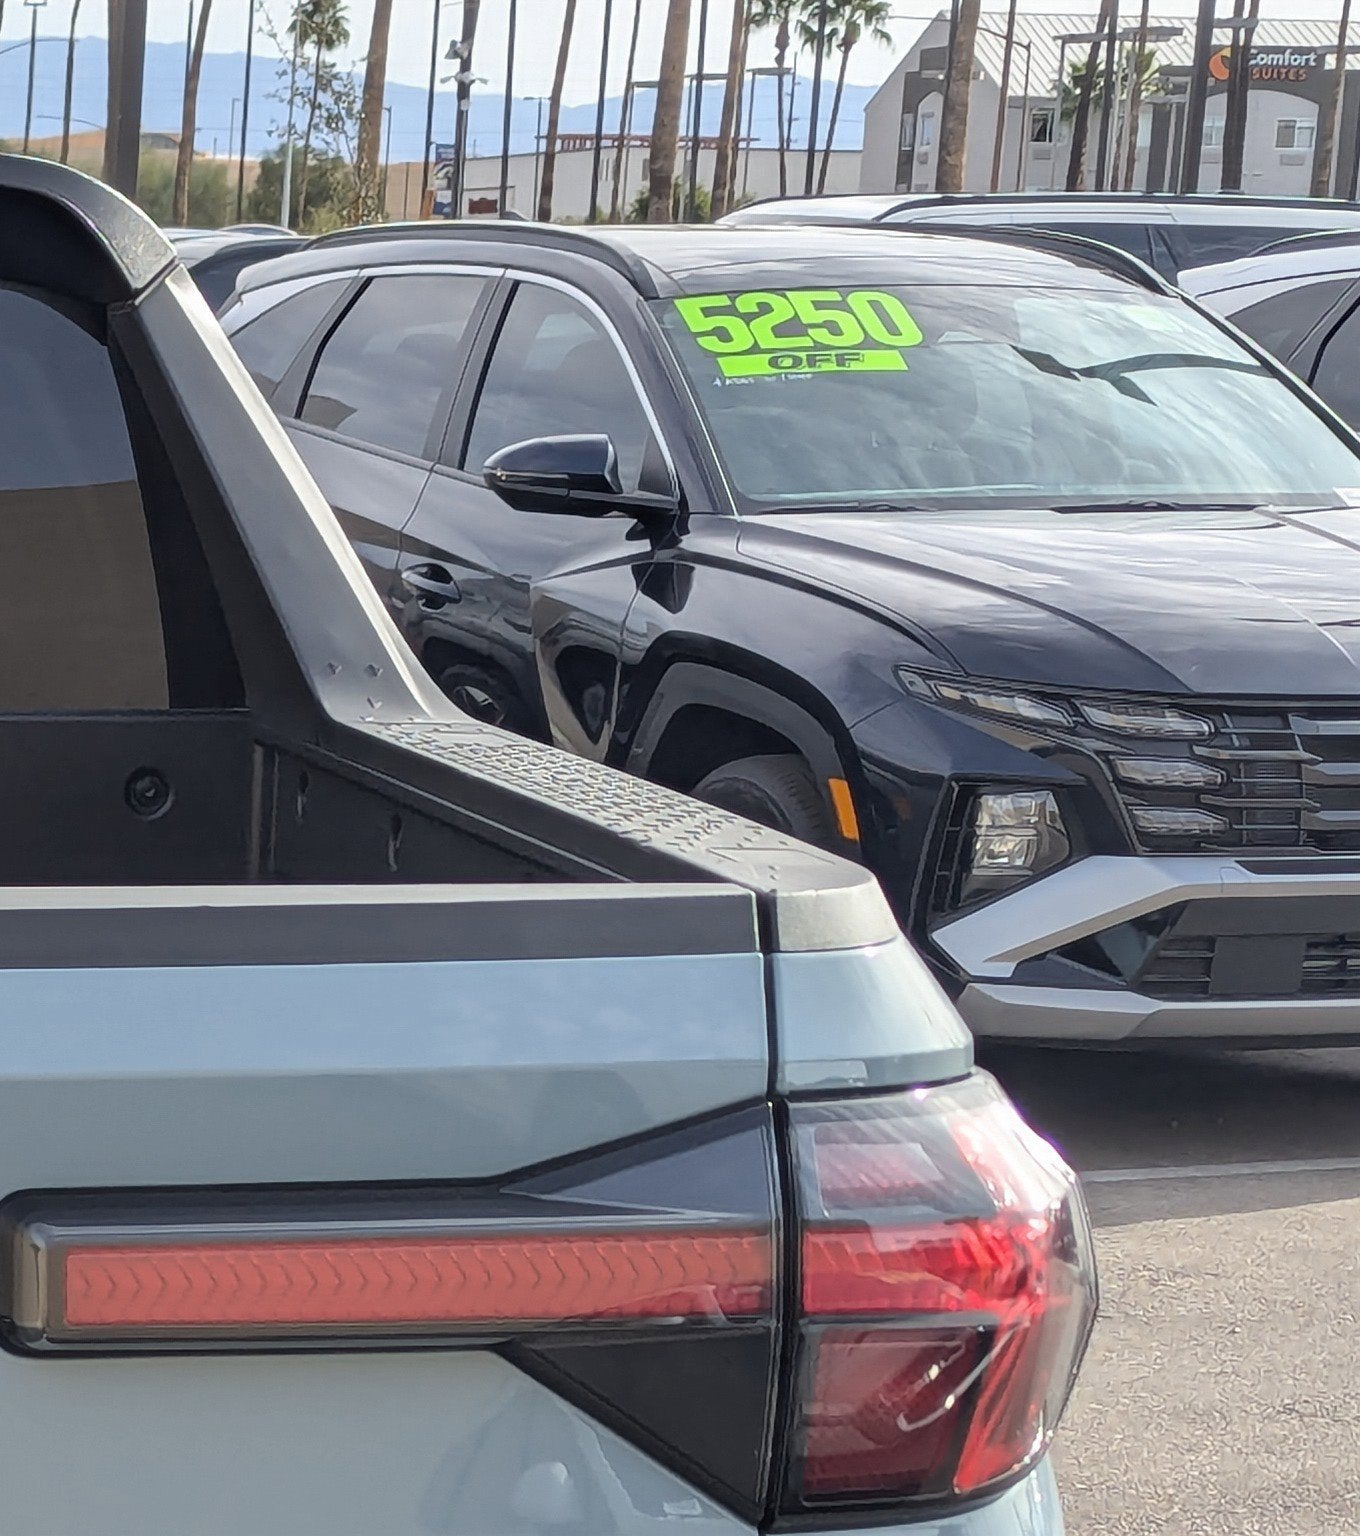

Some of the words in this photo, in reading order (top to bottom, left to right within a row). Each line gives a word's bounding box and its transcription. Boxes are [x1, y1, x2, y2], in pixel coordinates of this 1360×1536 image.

[1251, 67, 1308, 81] SUITES
[673, 290, 924, 354] 5250
[767, 352, 865, 370] OFF
